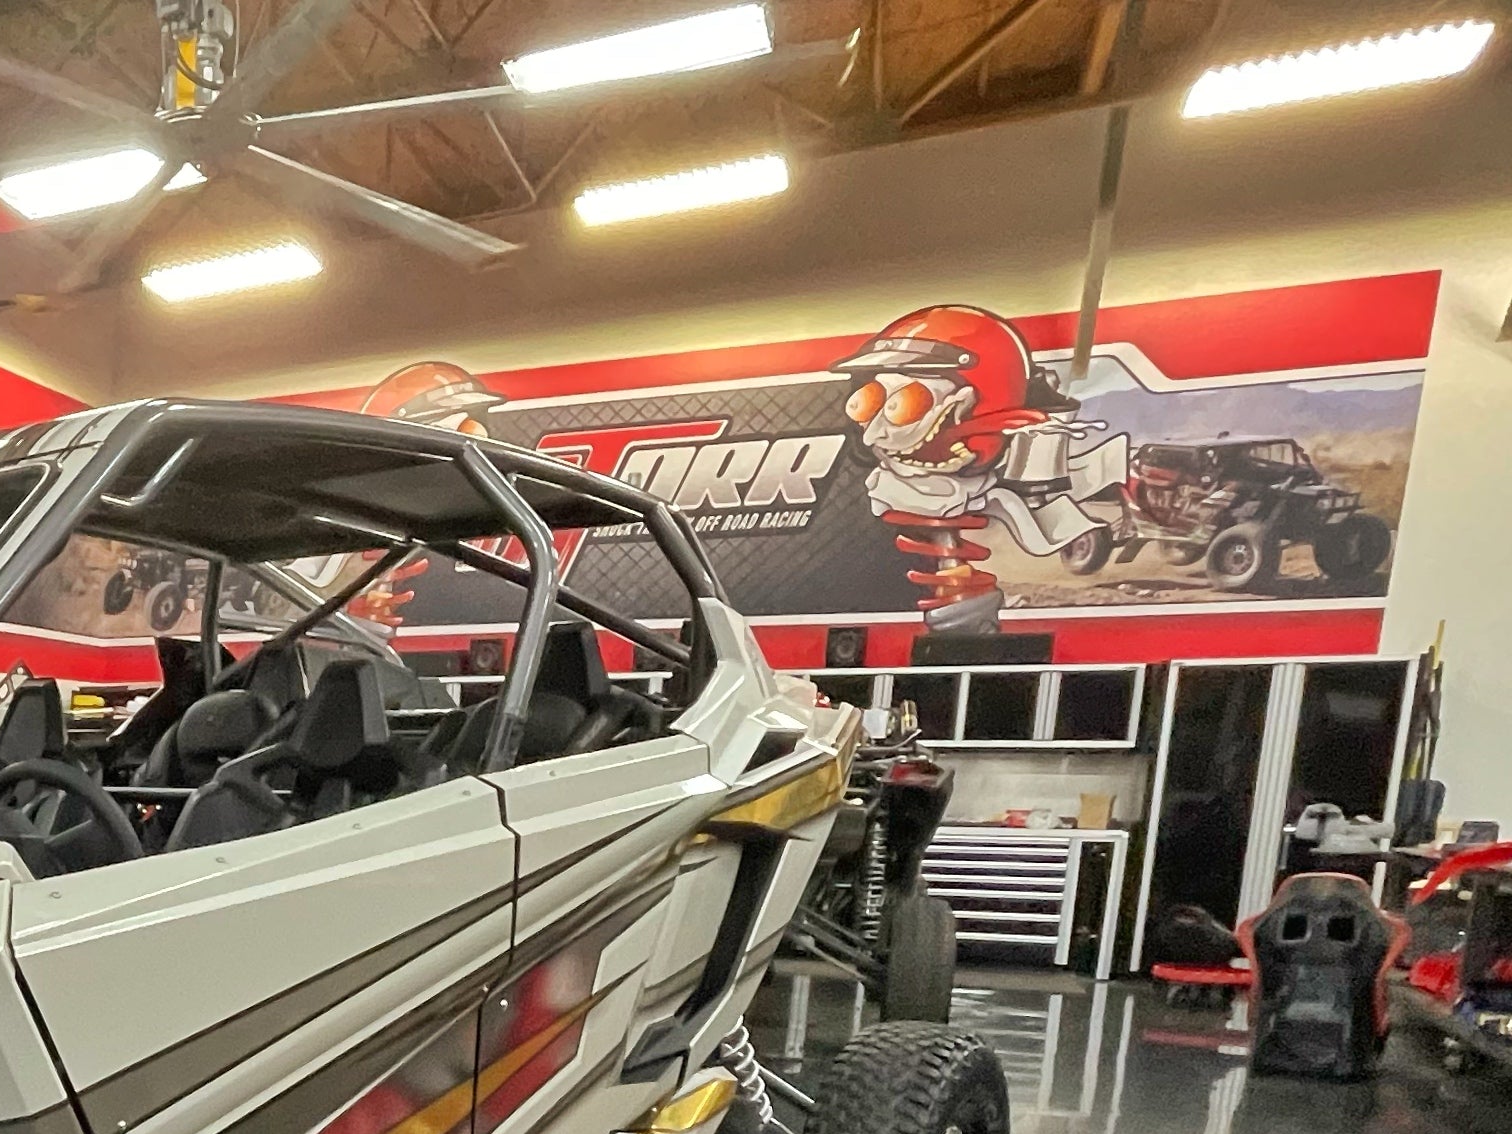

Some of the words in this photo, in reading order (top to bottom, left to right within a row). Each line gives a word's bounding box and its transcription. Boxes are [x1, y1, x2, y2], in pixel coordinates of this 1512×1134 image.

[694, 514, 721, 533] OFF
[721, 513, 761, 532] ROAD
[760, 510, 811, 530] RACING
